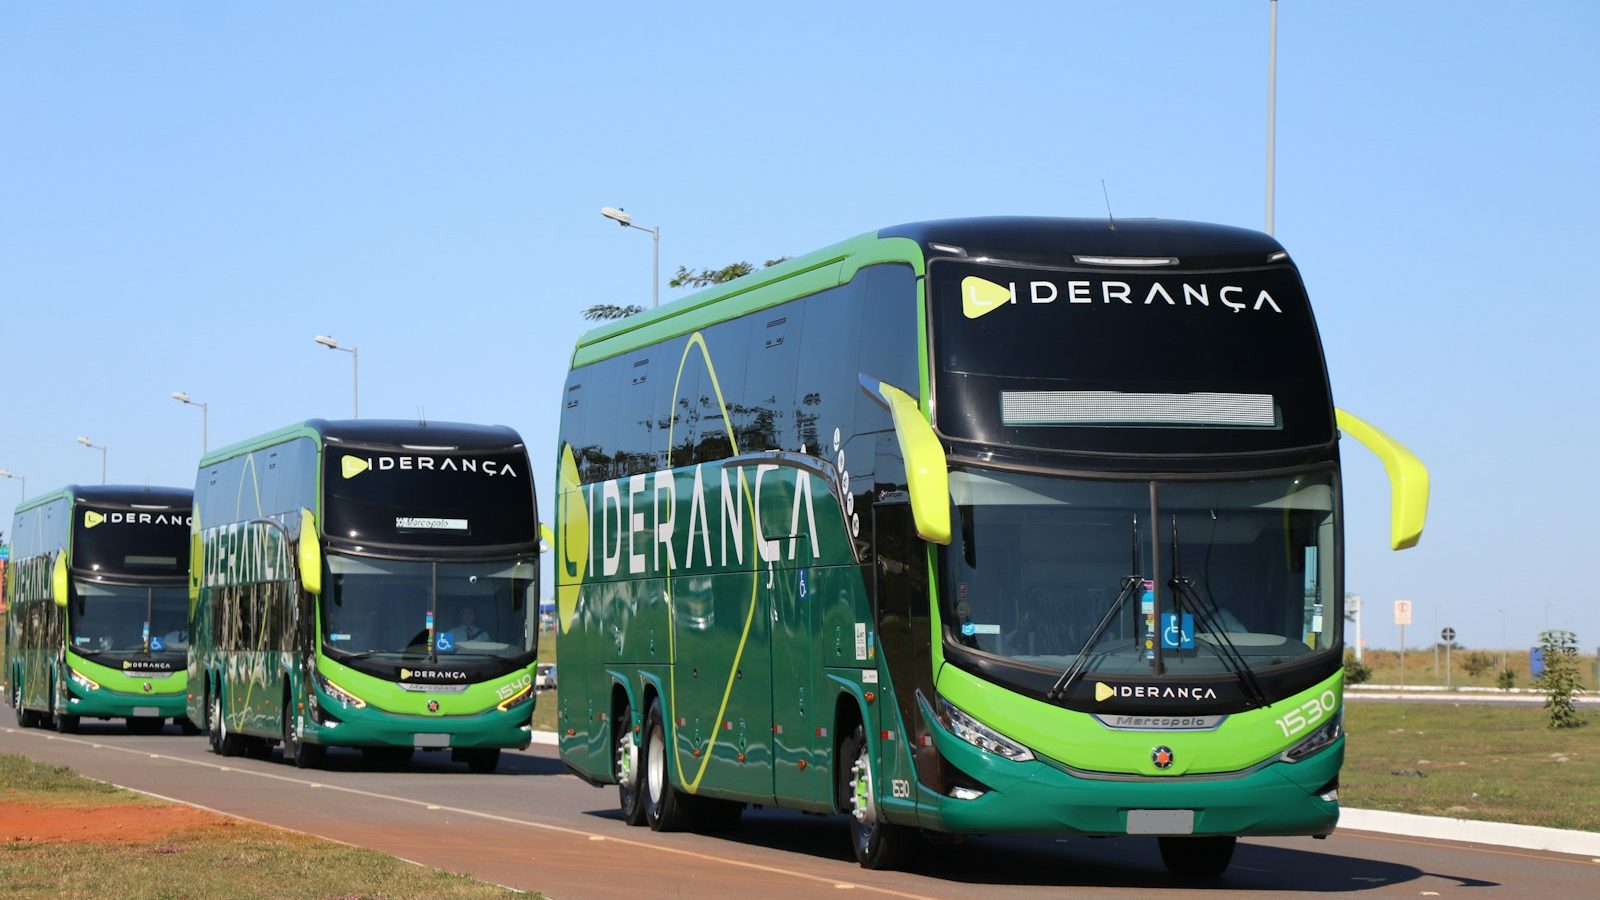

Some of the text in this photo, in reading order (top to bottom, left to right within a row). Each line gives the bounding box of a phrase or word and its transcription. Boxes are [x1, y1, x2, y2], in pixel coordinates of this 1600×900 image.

[969, 280, 1282, 313] LIDERANÇA
[346, 456, 517, 478] LIDERANÇA
[406, 517, 449, 528] Marcopolo
[564, 444, 820, 588] LIDERANÇA
[402, 670, 466, 679] IDERANÇA
[495, 673, 533, 700] 1540
[1098, 686, 1216, 700] LIDERANÇA
[1115, 715, 1206, 728] Marcopolo
[1275, 689, 1336, 737] 1530
[891, 779, 910, 798] 1530
